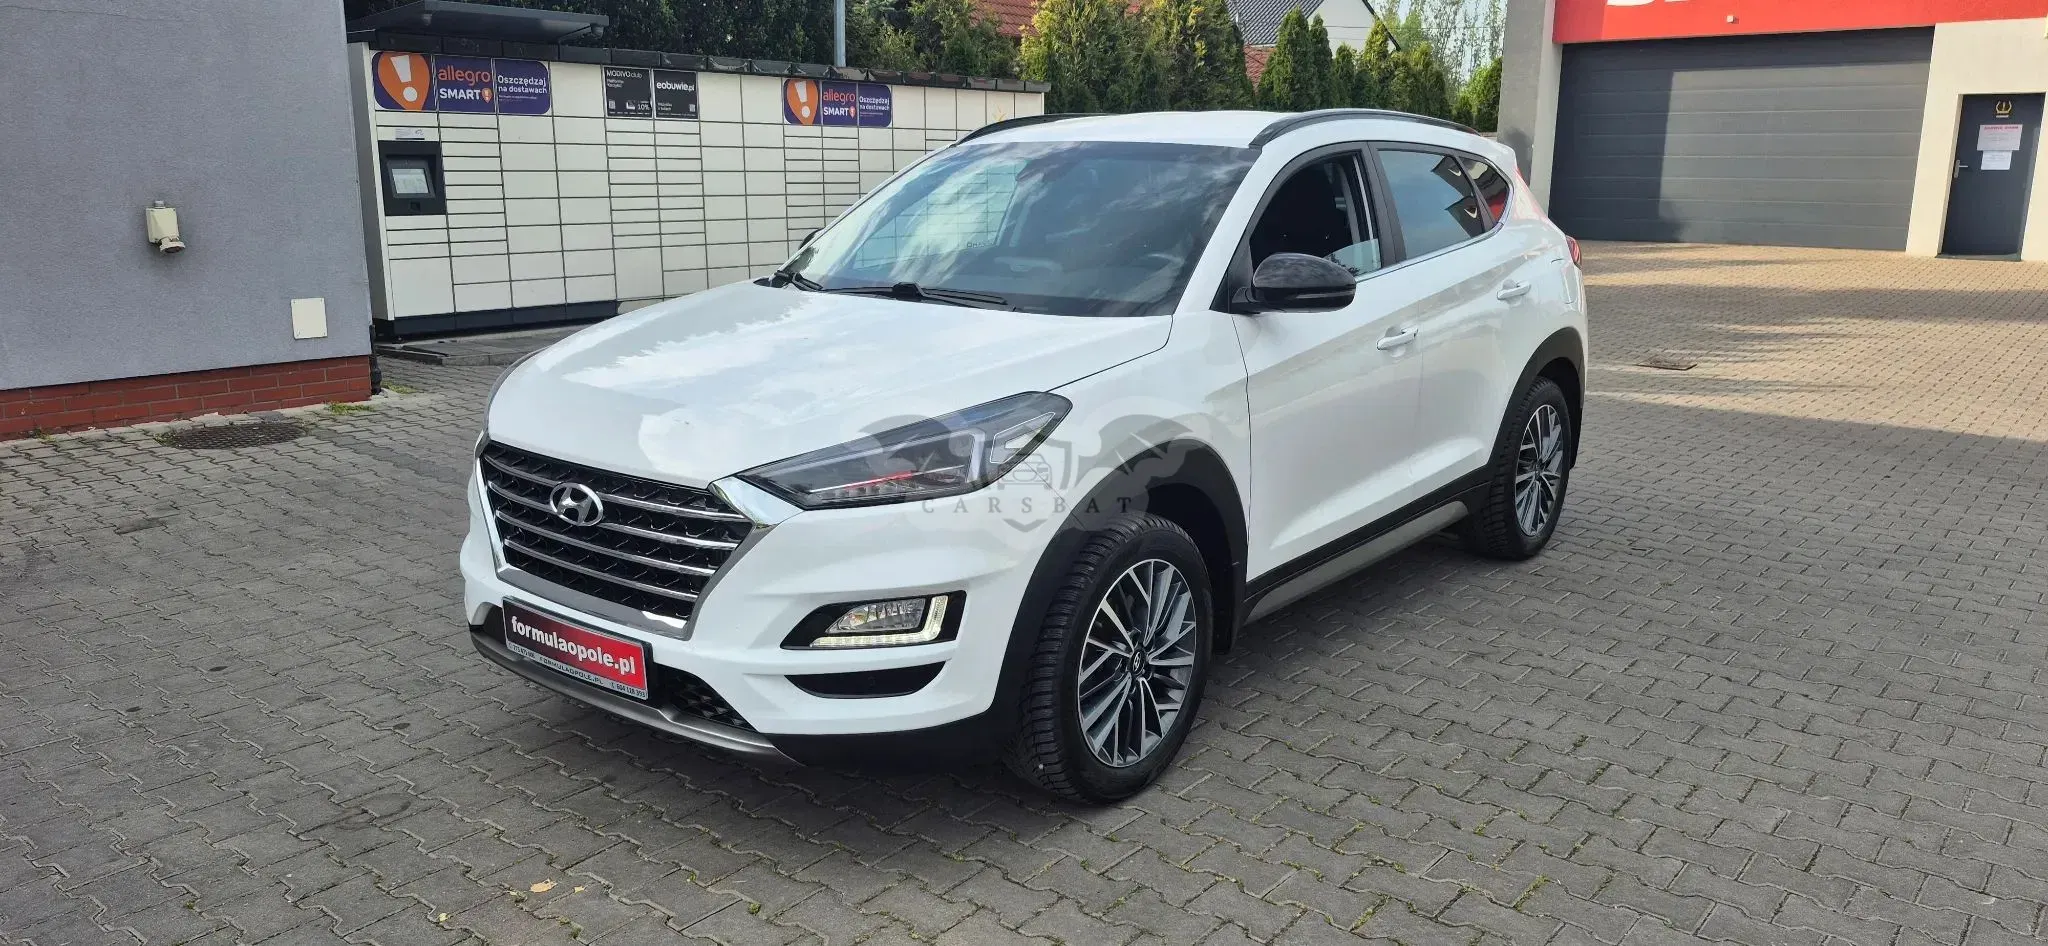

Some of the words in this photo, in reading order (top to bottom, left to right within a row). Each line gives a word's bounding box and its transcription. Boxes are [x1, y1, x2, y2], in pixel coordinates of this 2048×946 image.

[439, 65, 491, 86] allegro
[606, 69, 631, 78] MODIVO
[497, 75, 546, 87] Oszczędzaj
[656, 81, 695, 92] eobuwie.pl
[440, 88, 481, 100] SMART
[509, 85, 548, 94] dostawach
[823, 88, 856, 105] allegro
[859, 96, 890, 106] Oszczędzaj
[823, 106, 849, 116] SMART
[511, 615, 636, 676] formulaopole.pl
